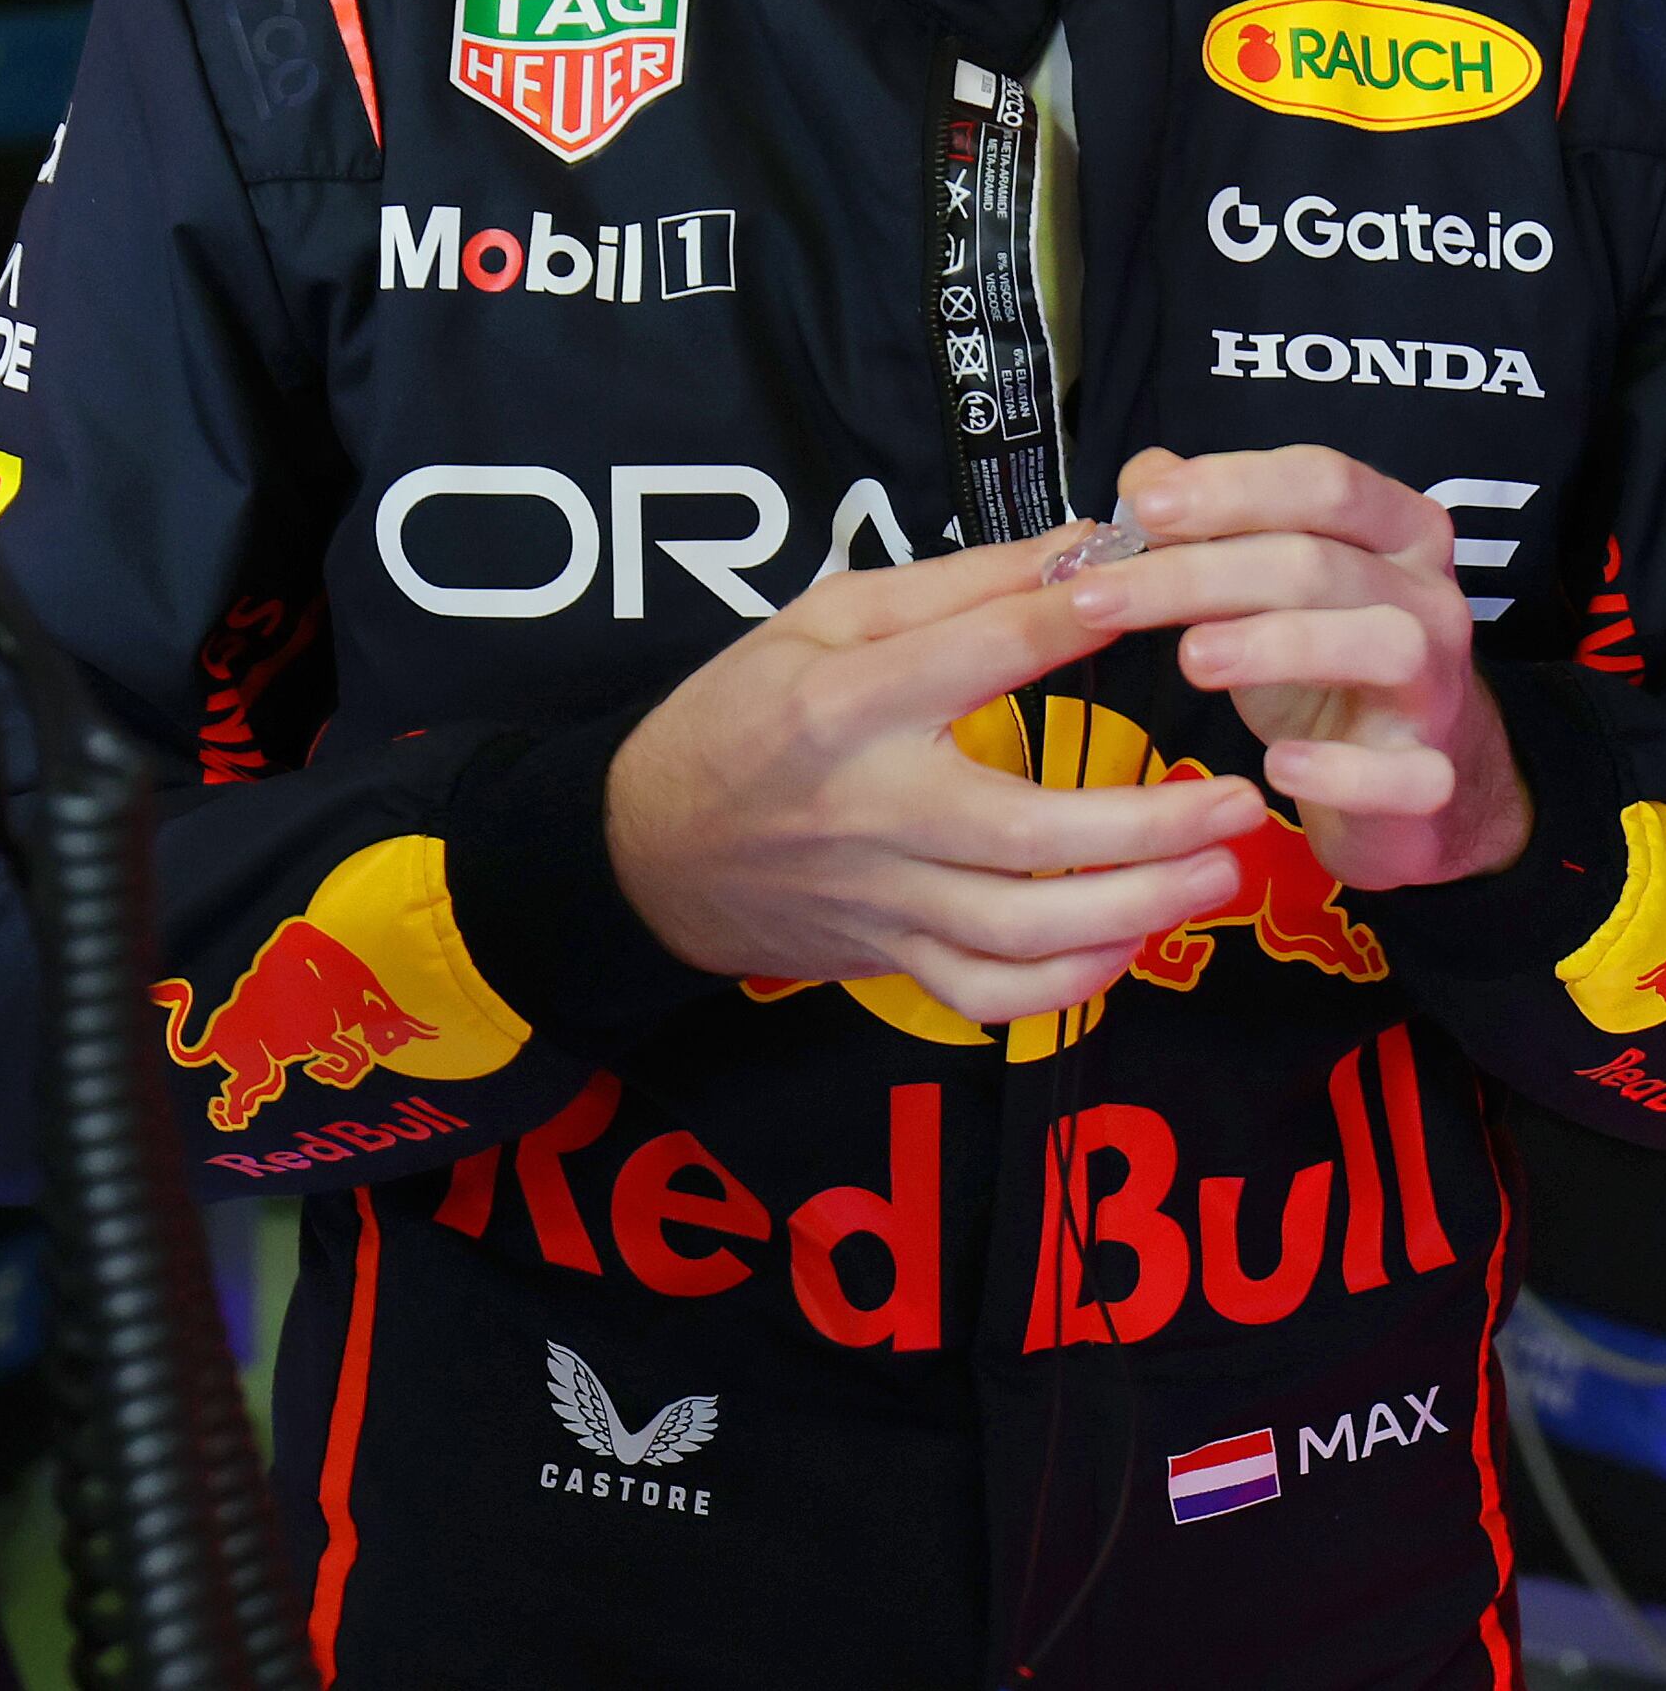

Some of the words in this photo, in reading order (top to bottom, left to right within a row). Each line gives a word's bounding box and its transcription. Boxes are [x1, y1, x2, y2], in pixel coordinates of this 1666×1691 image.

[464, 41, 667, 145] HEUER
[1289, 26, 1495, 95] RAUCH
[379, 205, 643, 304] Mobil
[1283, 197, 1555, 274] Gate.io
[1210, 328, 1546, 400] HONDA
[966, 395, 987, 430] 142
[204, 1132, 355, 1178] Red
[329, 1096, 471, 1153] Bull
[432, 1069, 942, 1353] Red
[1021, 1021, 1457, 1355] Bull
[1298, 1385, 1450, 1475] MAX
[540, 1463, 712, 1516] CASTORE
